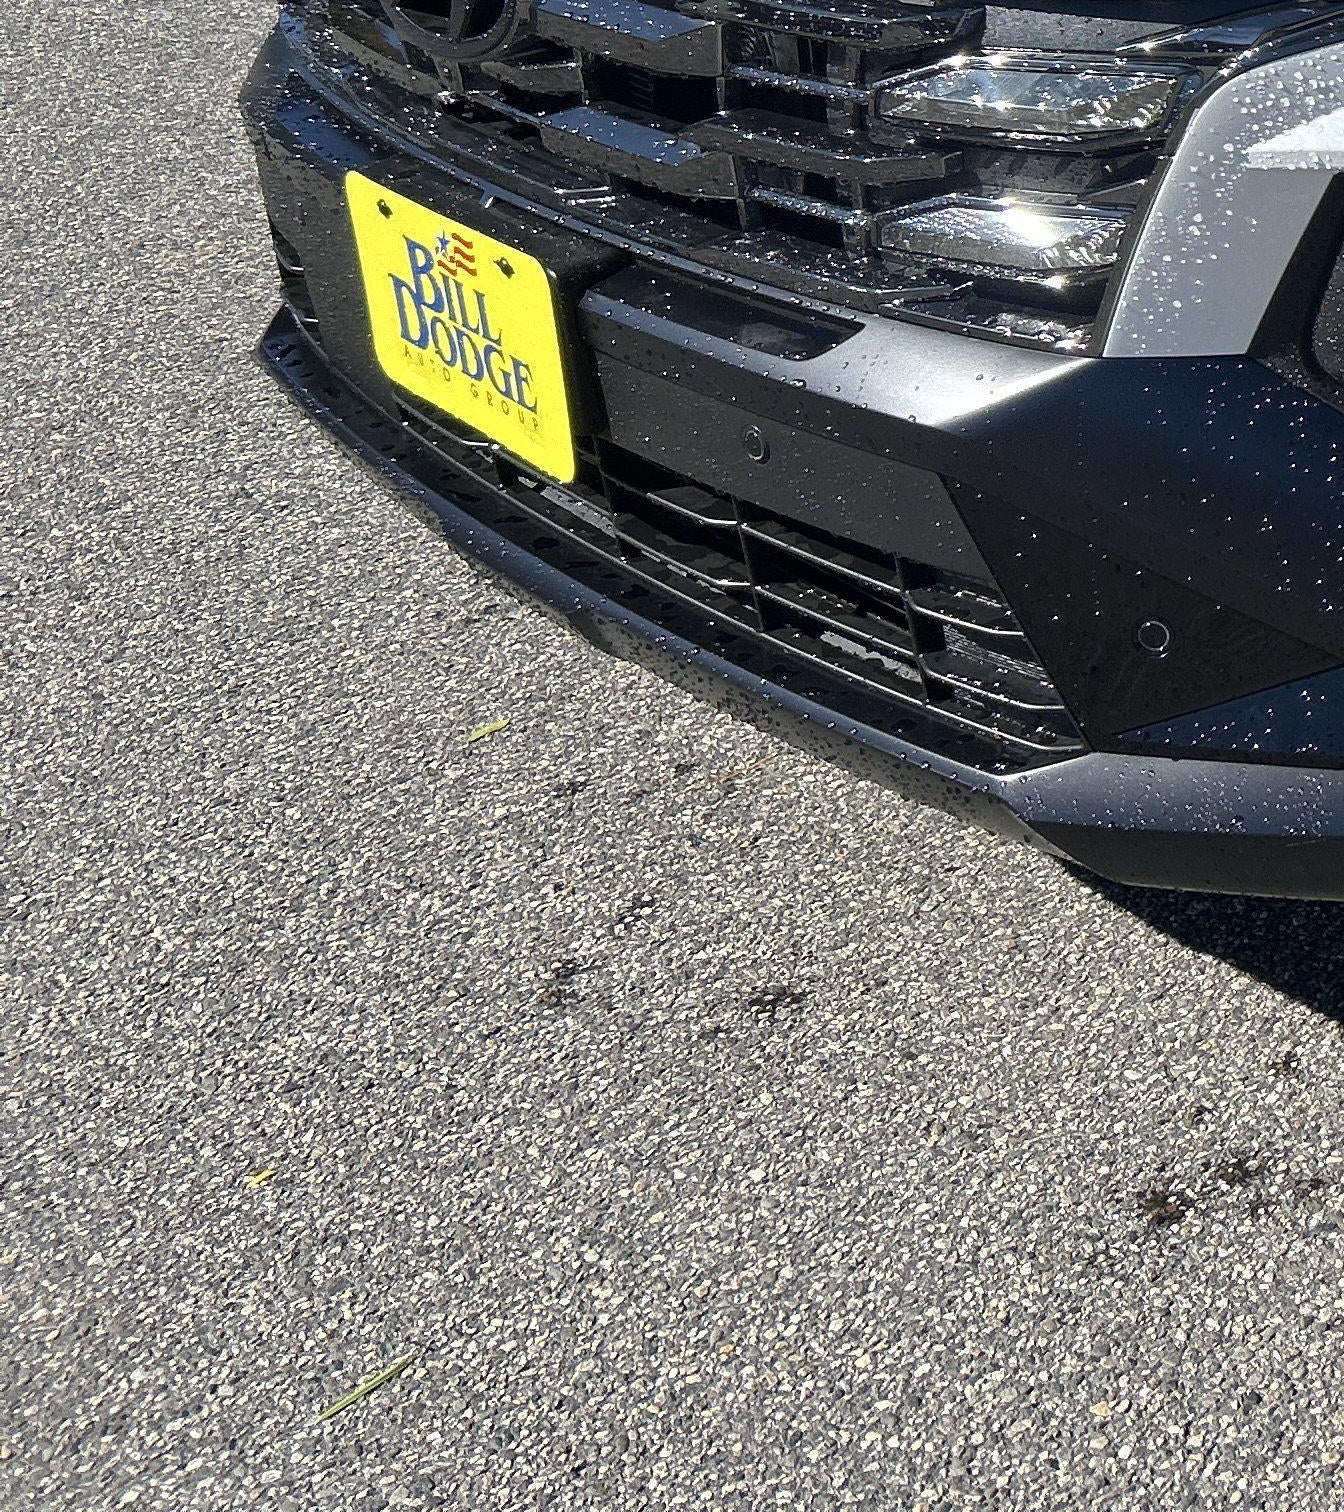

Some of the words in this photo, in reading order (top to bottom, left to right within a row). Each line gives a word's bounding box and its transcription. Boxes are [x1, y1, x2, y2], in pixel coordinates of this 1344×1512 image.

[388, 273, 538, 415] DODGE
[402, 234, 503, 346] BILL
[469, 381, 539, 432] GROUP
